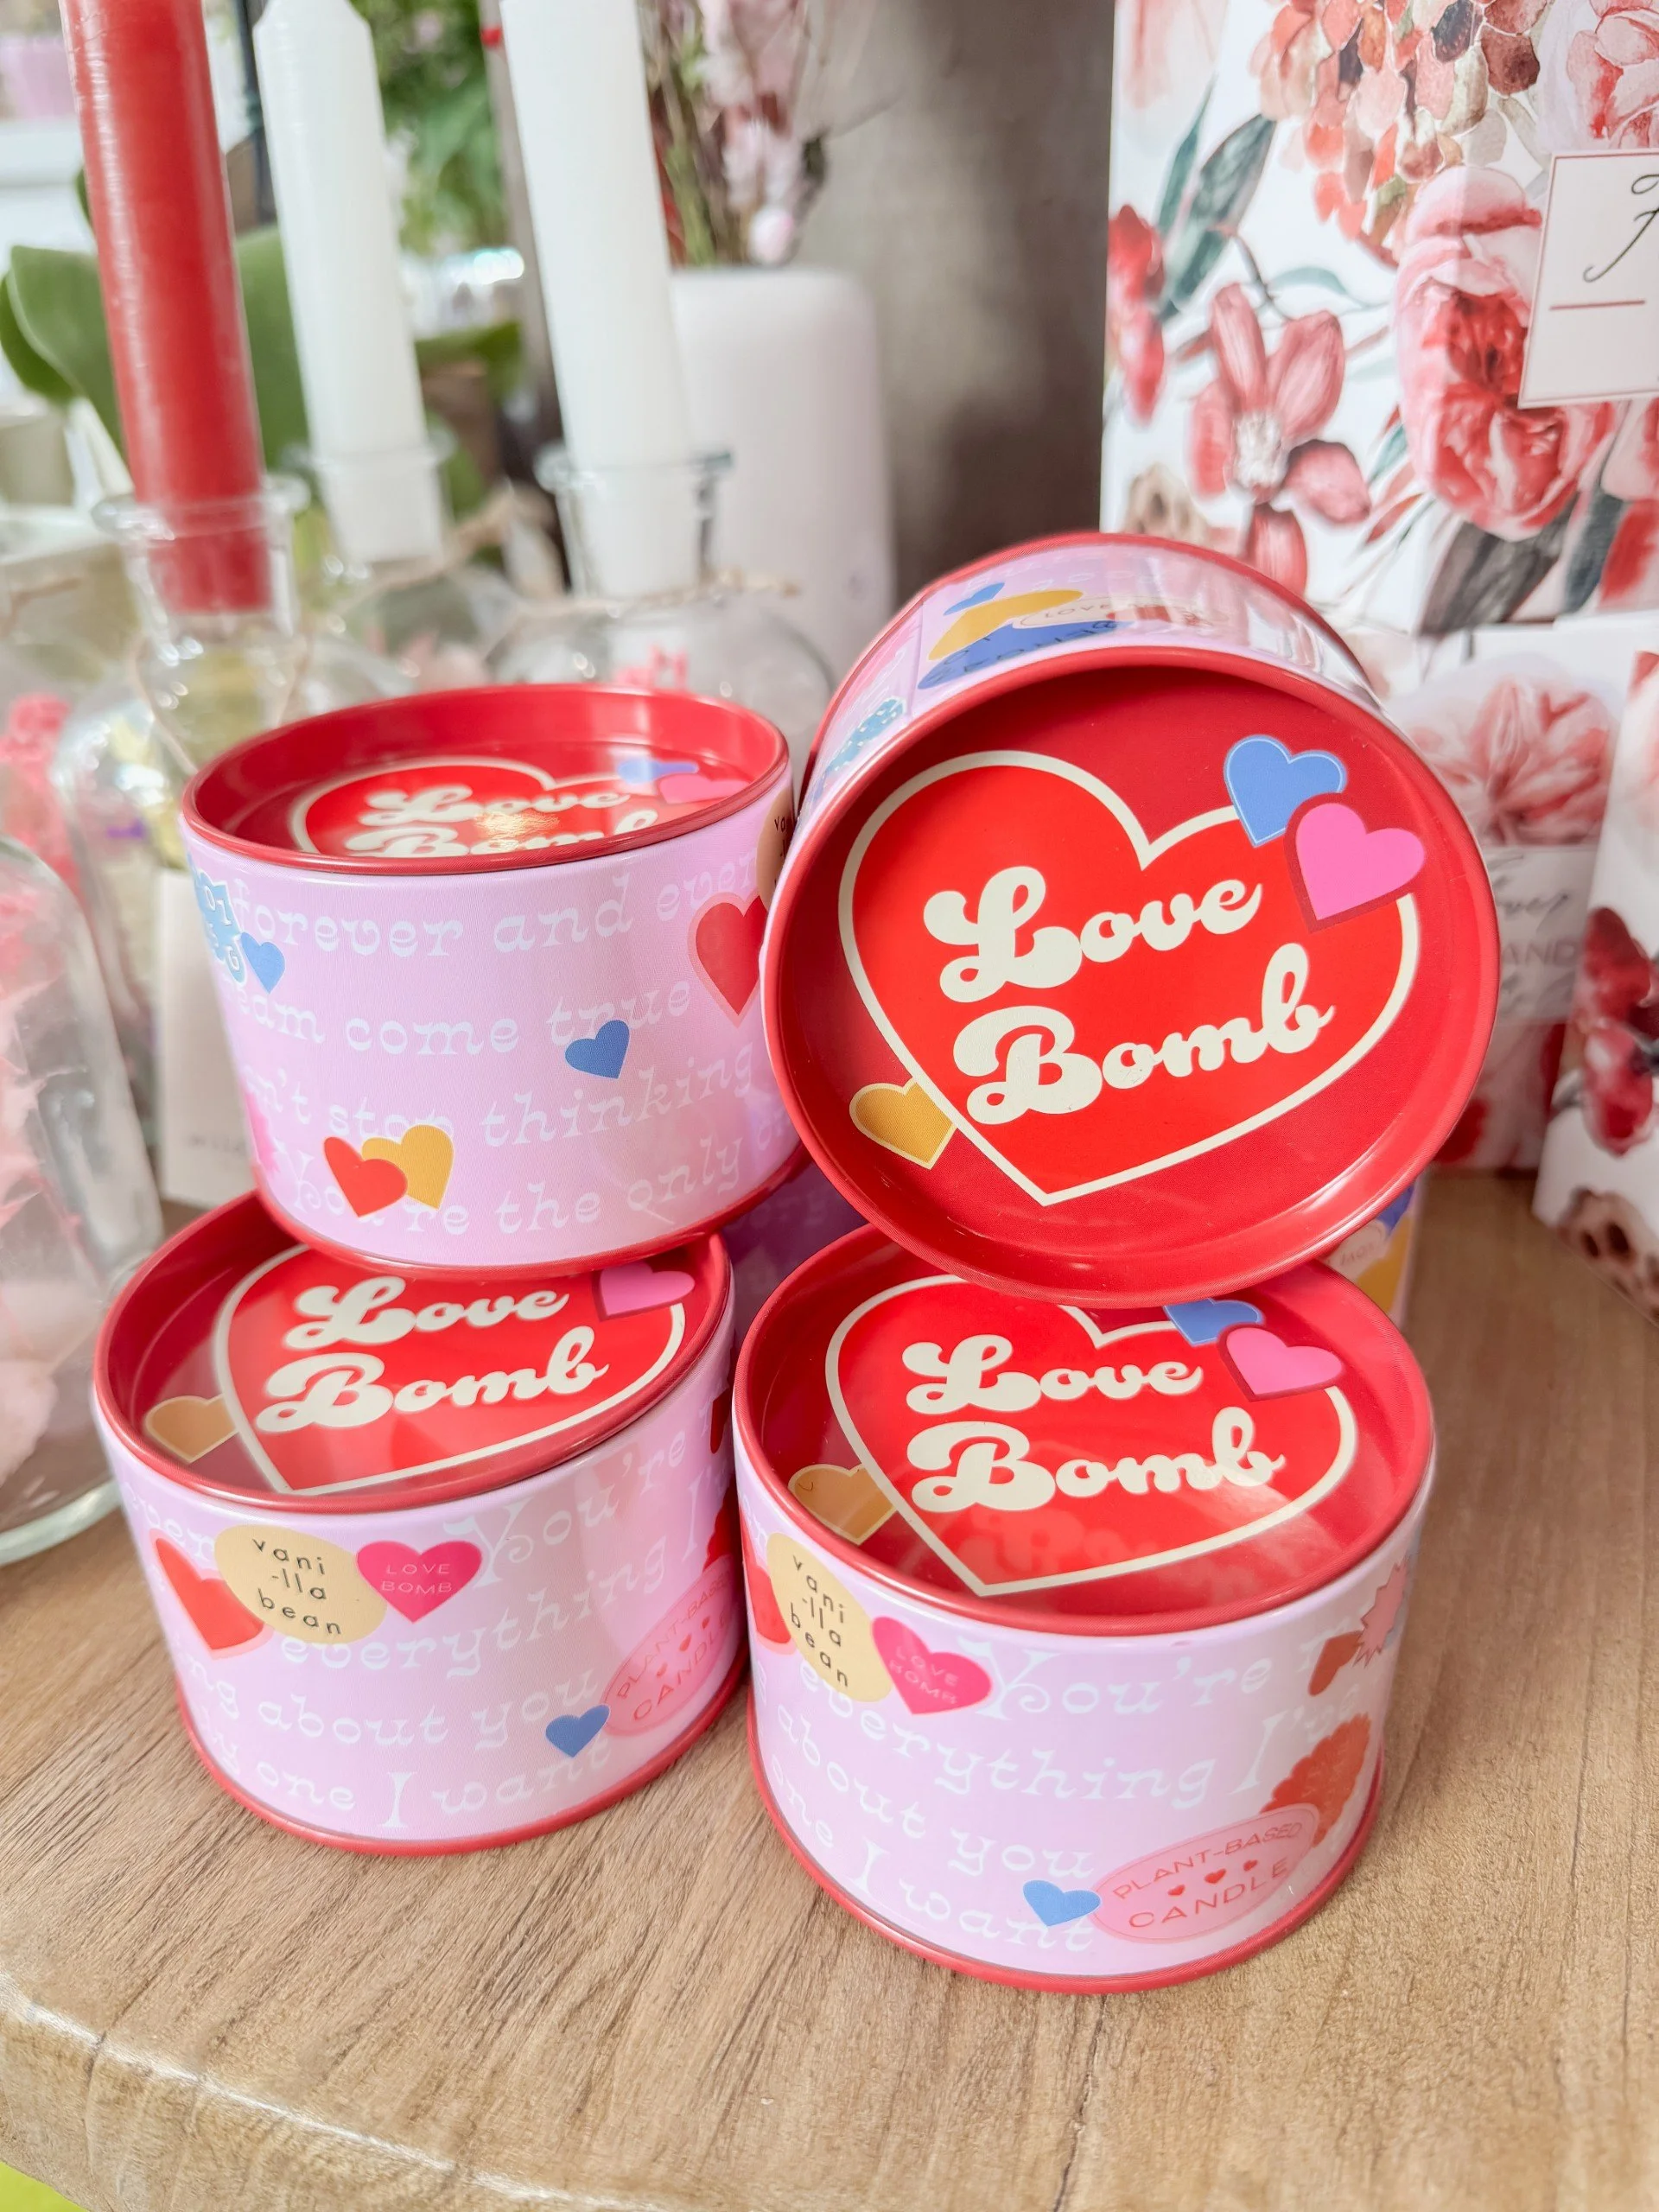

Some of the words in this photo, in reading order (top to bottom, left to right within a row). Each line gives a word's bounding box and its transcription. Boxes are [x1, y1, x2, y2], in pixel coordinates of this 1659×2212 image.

[359, 785, 631, 826] Love
[232, 878, 464, 957] forever
[493, 873, 635, 953] and
[923, 866, 1262, 1003] Love
[347, 1013, 518, 1056] come
[546, 980, 691, 1046] true
[953, 944, 1334, 1125] Bomb
[480, 1041, 754, 1147] thinking
[495, 1181, 601, 1234] the
[626, 1130, 744, 1224] only
[283, 1275, 569, 1351] Love
[255, 1325, 609, 1432] Bomb
[902, 1334, 1203, 1414] Love
[906, 1406, 1287, 1513] Bomb
[444, 1431, 686, 1589] You're
[252, 1537, 326, 1575] vani
[271, 1567, 327, 1599] -lla
[380, 1580, 453, 1596] BOMB
[385, 1561, 451, 1576] LOVE
[792, 1554, 847, 1624] vani
[257, 1587, 341, 1635] bean
[282, 1533, 668, 1678] everything
[790, 1601, 849, 1688] bean
[802, 1596, 842, 1648] -lla
[889, 1659, 958, 1705] BOMB
[895, 1645, 959, 1686] LOVE
[956, 1636, 1273, 1720] You're
[257, 1694, 449, 1746] about
[472, 1669, 598, 1750] you
[799, 1661, 1217, 1809] everything
[257, 1760, 356, 1811] one
[378, 1771, 419, 1827] I
[432, 1735, 613, 1816] want
[777, 1703, 927, 1840] about
[947, 1827, 1096, 1878] you
[772, 1754, 835, 1848] one
[899, 1878, 1095, 1953] want
[1113, 1821, 1303, 1900] PLANT-BASED
[1128, 1856, 1290, 1929] CANDLE
